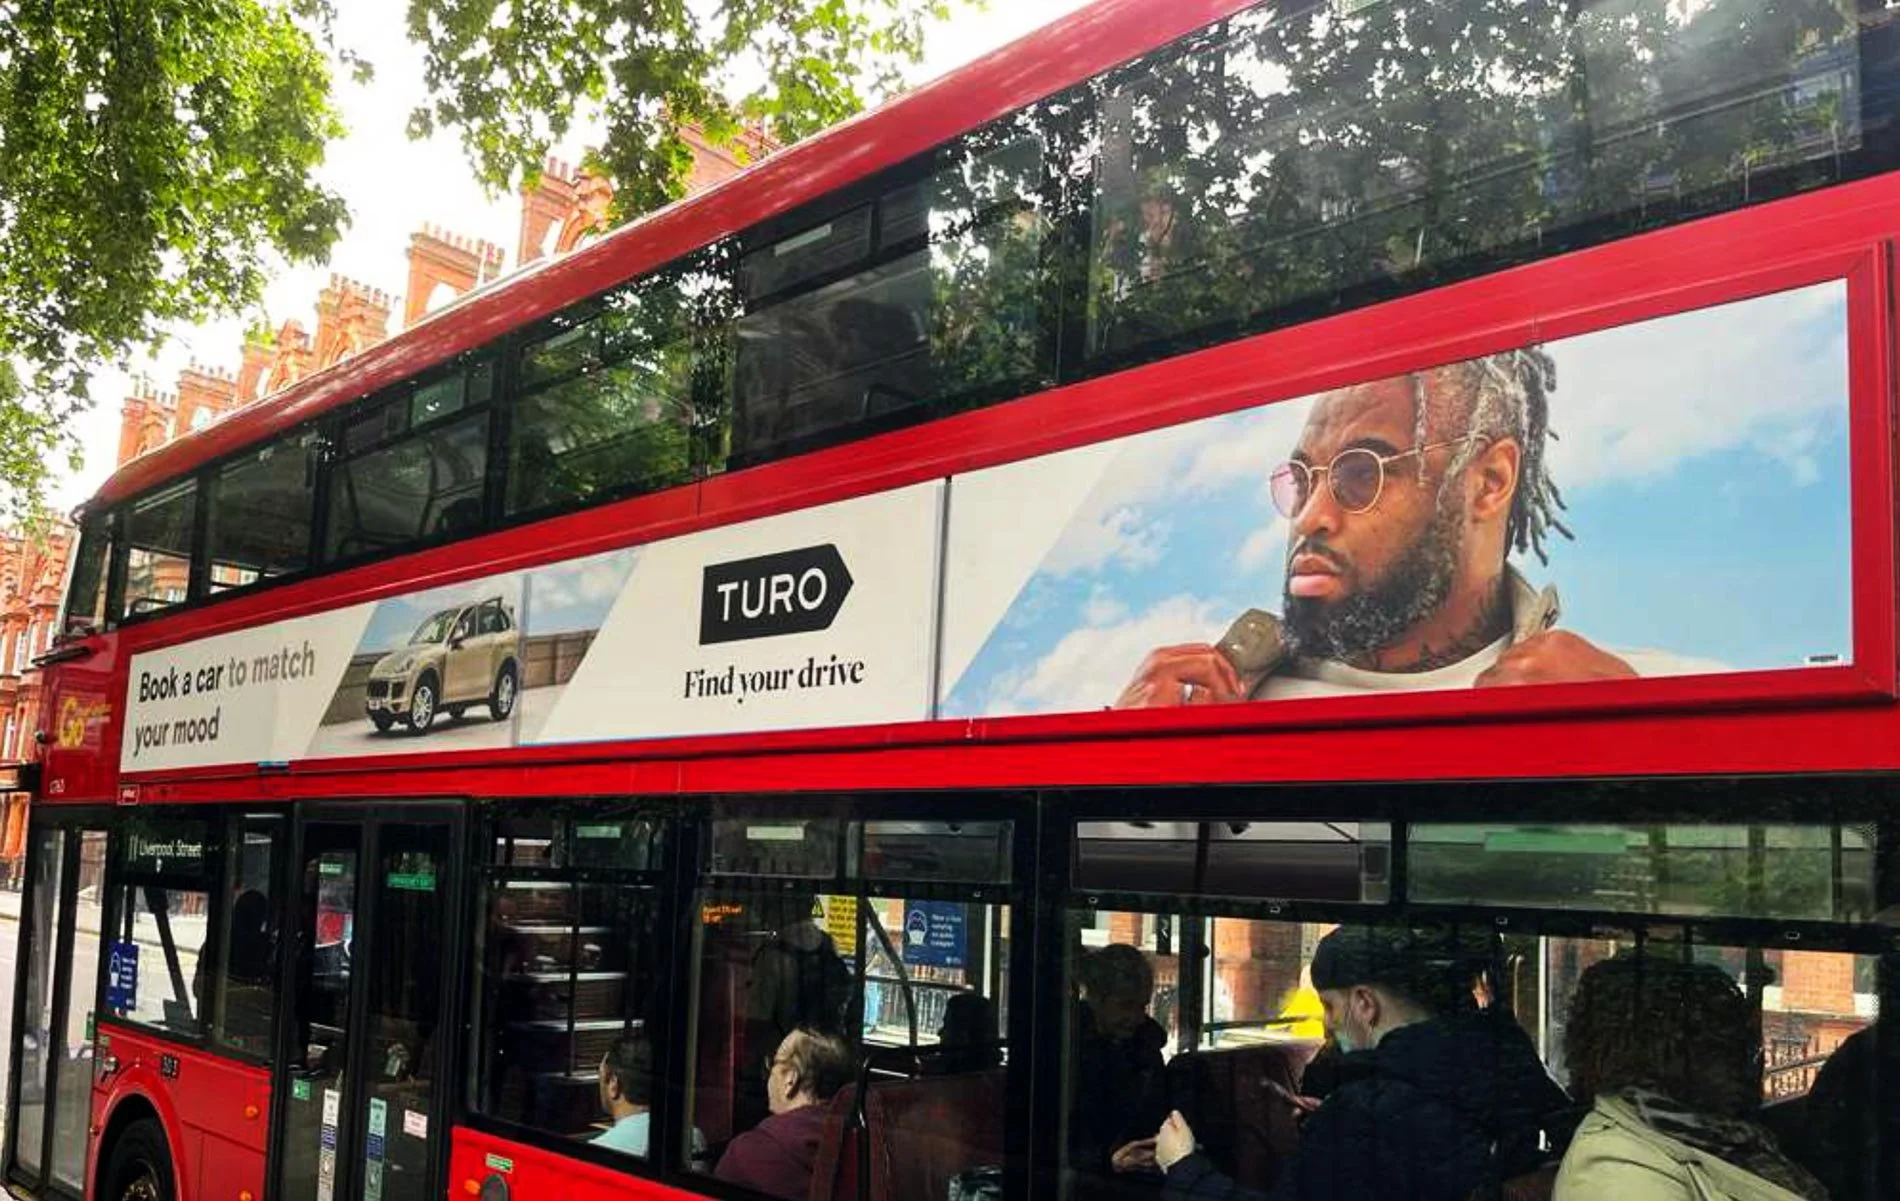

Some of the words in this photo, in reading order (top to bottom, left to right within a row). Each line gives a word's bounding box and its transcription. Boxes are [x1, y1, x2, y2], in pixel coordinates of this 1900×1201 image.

[717, 567, 828, 621] TURO
[138, 666, 179, 702] Book
[182, 672, 192, 695] a
[196, 664, 225, 694] car
[228, 656, 248, 688] to
[251, 640, 316, 684] match
[683, 665, 735, 698] Find
[737, 668, 794, 704] your
[797, 654, 865, 688] drive
[133, 722, 170, 757] your
[171, 706, 221, 744] mood
[176, 839, 202, 858] Street
